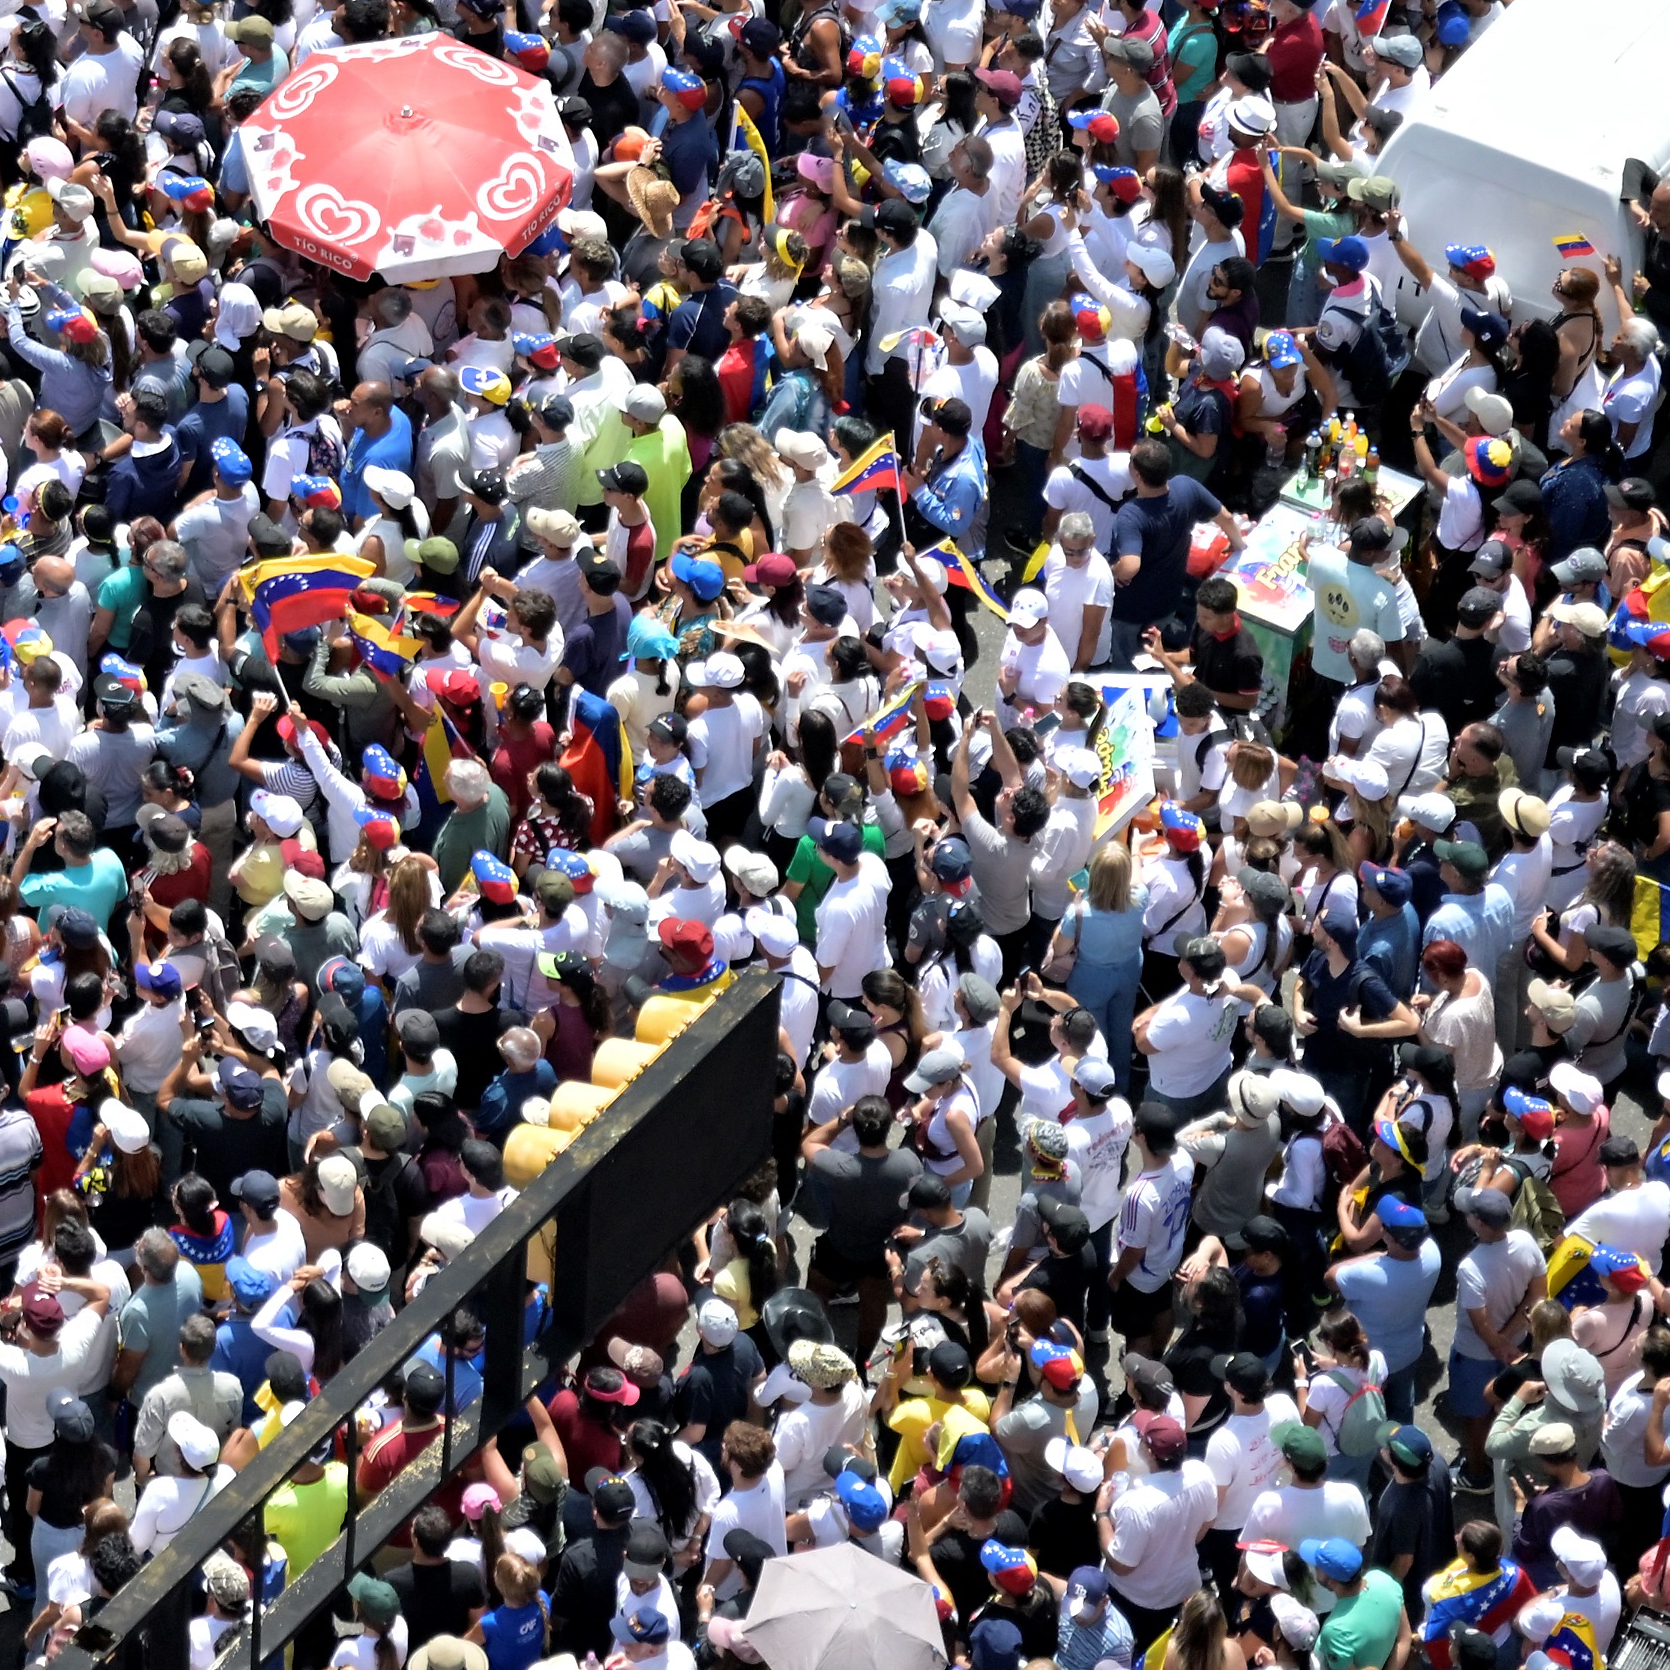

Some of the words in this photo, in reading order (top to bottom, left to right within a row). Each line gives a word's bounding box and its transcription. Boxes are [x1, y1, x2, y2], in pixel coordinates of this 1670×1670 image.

[521, 219, 540, 241] TÍO
[539, 194, 562, 226] RICO
[293, 234, 317, 255] TÍO
[319, 247, 353, 270] RICO
